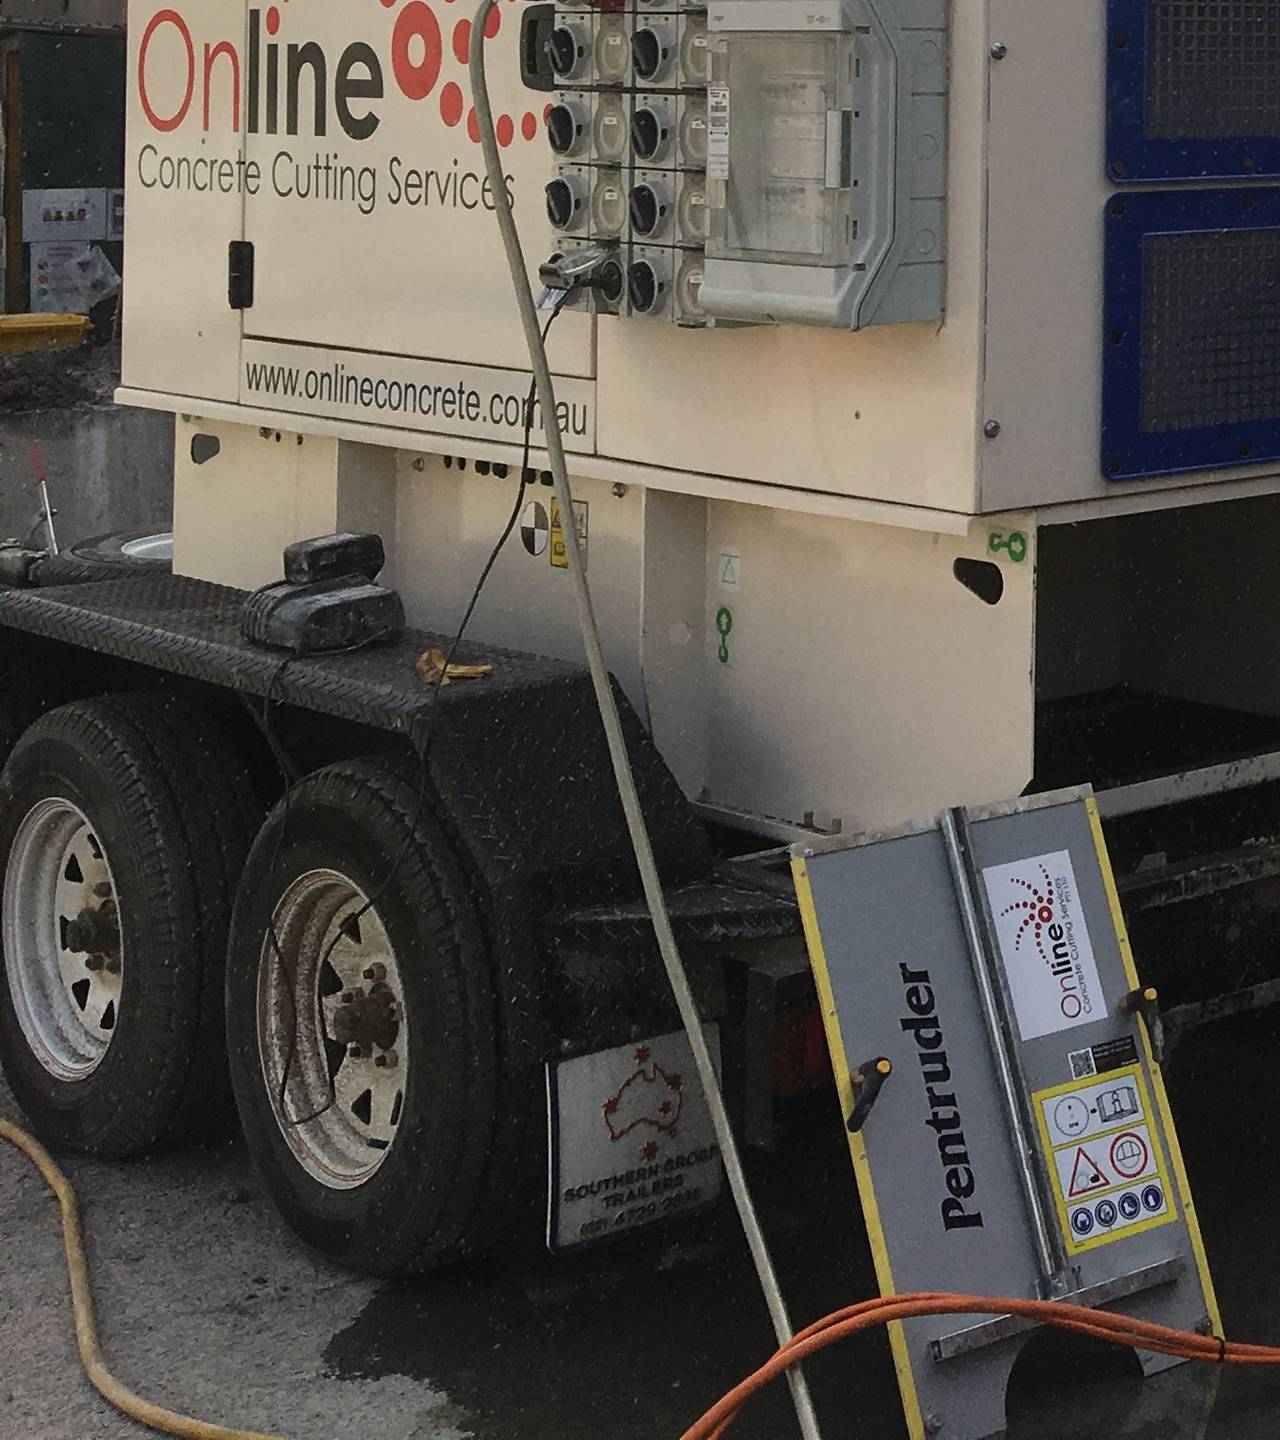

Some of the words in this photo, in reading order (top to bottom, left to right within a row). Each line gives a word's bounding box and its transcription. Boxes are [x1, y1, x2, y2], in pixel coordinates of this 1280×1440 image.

[138, 5, 384, 140] Online
[138, 144, 260, 194] Concrete
[272, 151, 376, 214] Cutting
[388, 157, 515, 210] Services
[246, 362, 587, 435] www.onlineconcrete.comau
[1054, 876, 1070, 920] Services
[1048, 923, 1082, 1019] Online
[1065, 921, 1080, 961] Cutting
[1075, 963, 1093, 1014] Concrete
[899, 962, 983, 1232] Pentruder
[564, 1163, 659, 1203] SOUTHERN
